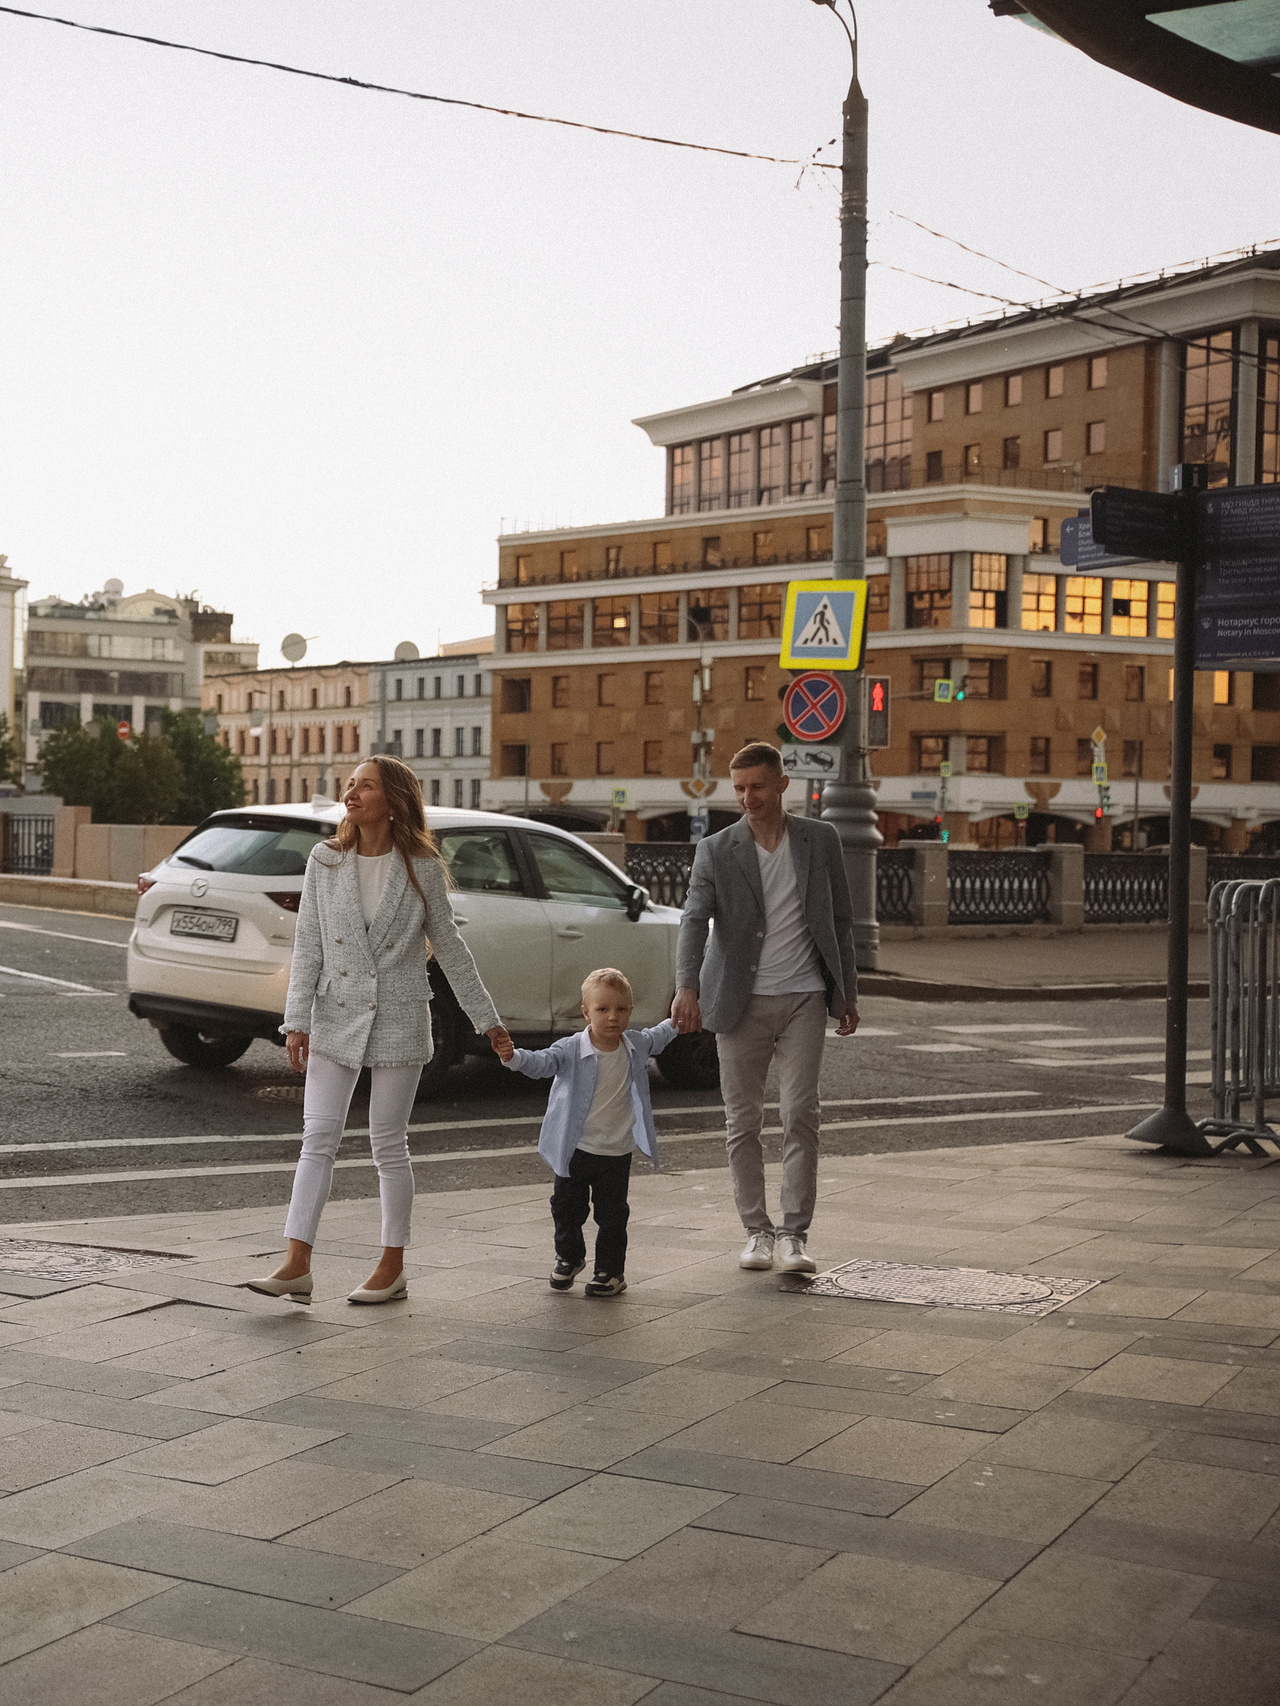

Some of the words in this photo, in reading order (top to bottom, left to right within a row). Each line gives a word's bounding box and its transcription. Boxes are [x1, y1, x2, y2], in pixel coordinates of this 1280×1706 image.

[1217, 618, 1259, 628] Нотариус
[1217, 629, 1243, 638] Notary
[1244, 628, 1252, 636] in
